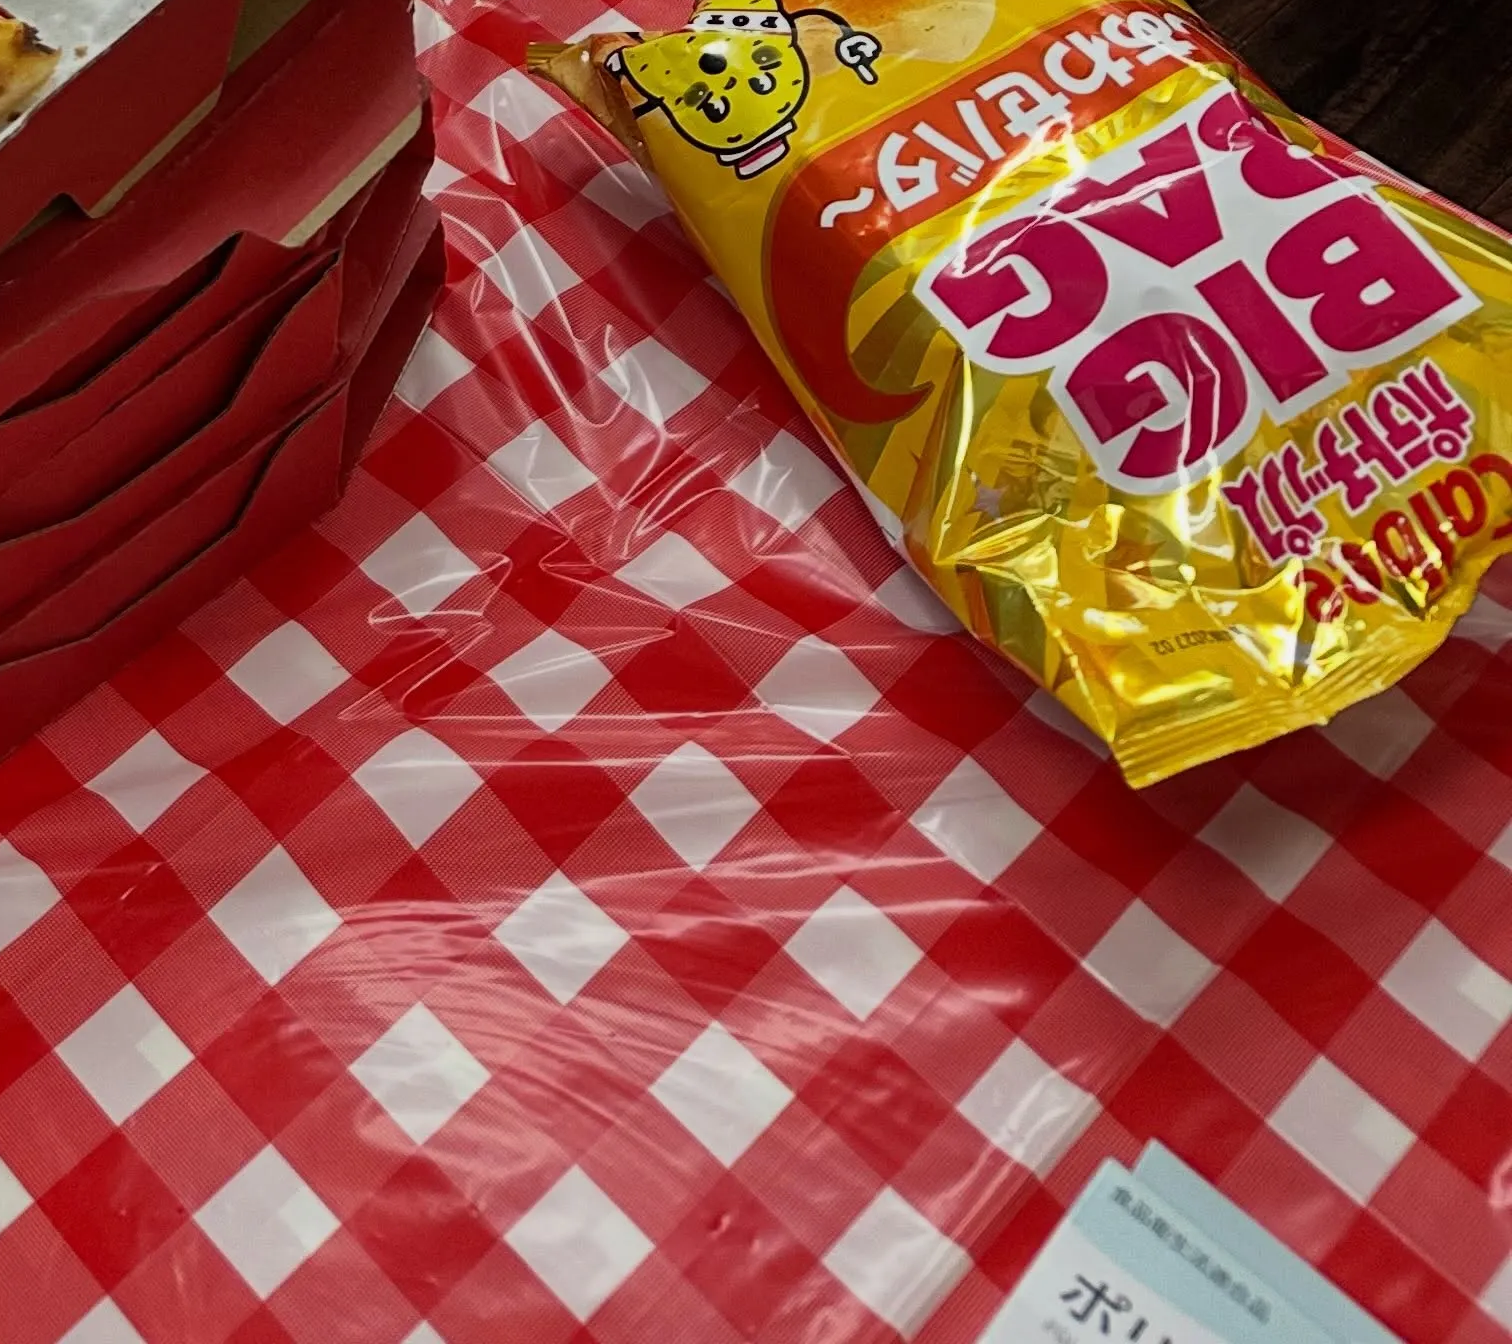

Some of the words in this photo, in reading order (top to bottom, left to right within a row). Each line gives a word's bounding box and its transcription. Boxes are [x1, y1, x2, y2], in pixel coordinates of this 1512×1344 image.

[930, 91, 1361, 359] BAG
[1066, 195, 1460, 477] BIG
[1221, 357, 1475, 568] ポテトチップス
